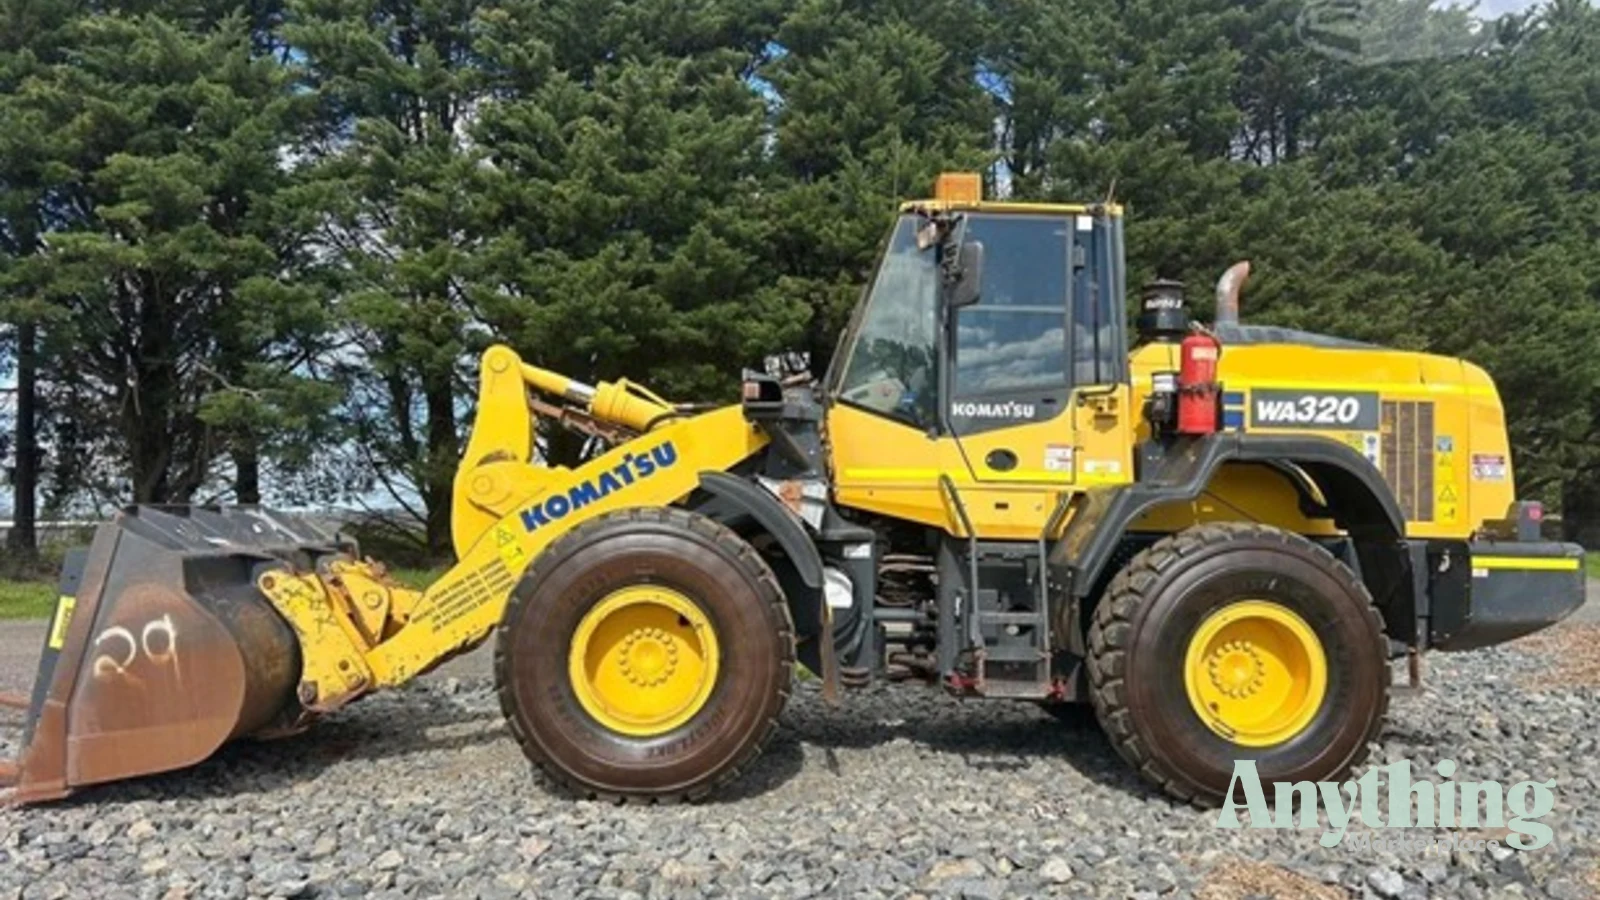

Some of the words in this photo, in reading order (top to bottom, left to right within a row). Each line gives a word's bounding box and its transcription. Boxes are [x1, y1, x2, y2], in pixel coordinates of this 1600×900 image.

[952, 401, 1036, 419] KOMATSU
[1257, 396, 1359, 425] WA320
[521, 442, 677, 532] KOMATSU
[94, 614, 181, 682] 29
